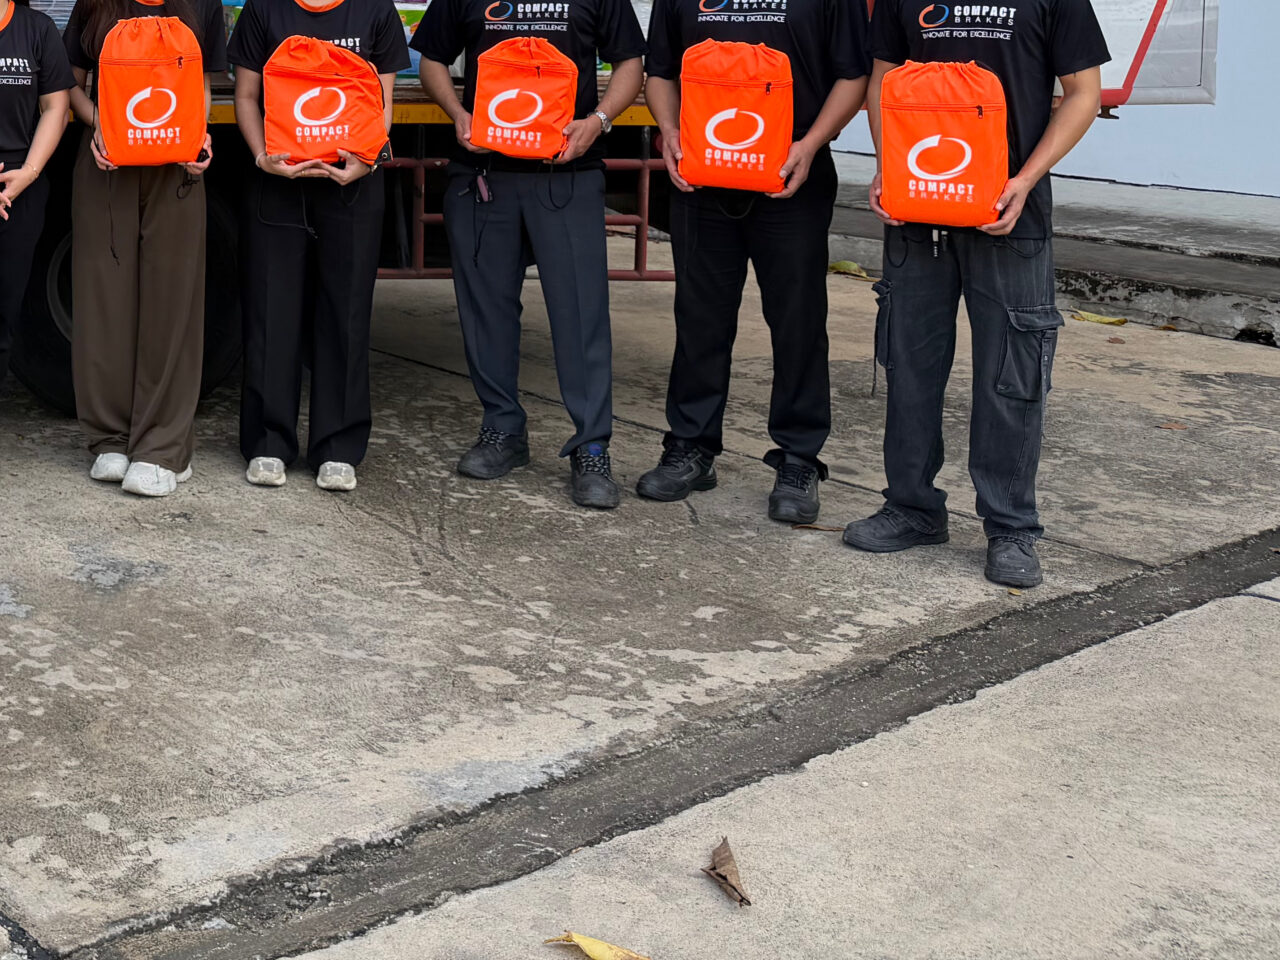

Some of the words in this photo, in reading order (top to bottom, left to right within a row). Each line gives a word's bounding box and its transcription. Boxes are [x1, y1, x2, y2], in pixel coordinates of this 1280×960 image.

[517, 3, 569, 13] COMPACT
[733, 2, 787, 10] BRAKES
[954, 5, 1016, 19] COMPACT
[746, 15, 785, 23] EXCELLENCE
[954, 16, 1014, 26] BRAKES
[922, 30, 950, 39] INNOVATE
[953, 30, 967, 38] FOR
[969, 30, 1011, 40] EXCELLENCE
[127, 127, 180, 139] COMPACT
[295, 124, 350, 136] COMPACT
[487, 126, 542, 141] COMPACT
[705, 148, 766, 164] COMPACT
[908, 179, 975, 195] COMPACT
[909, 190, 974, 203] BRAKES
